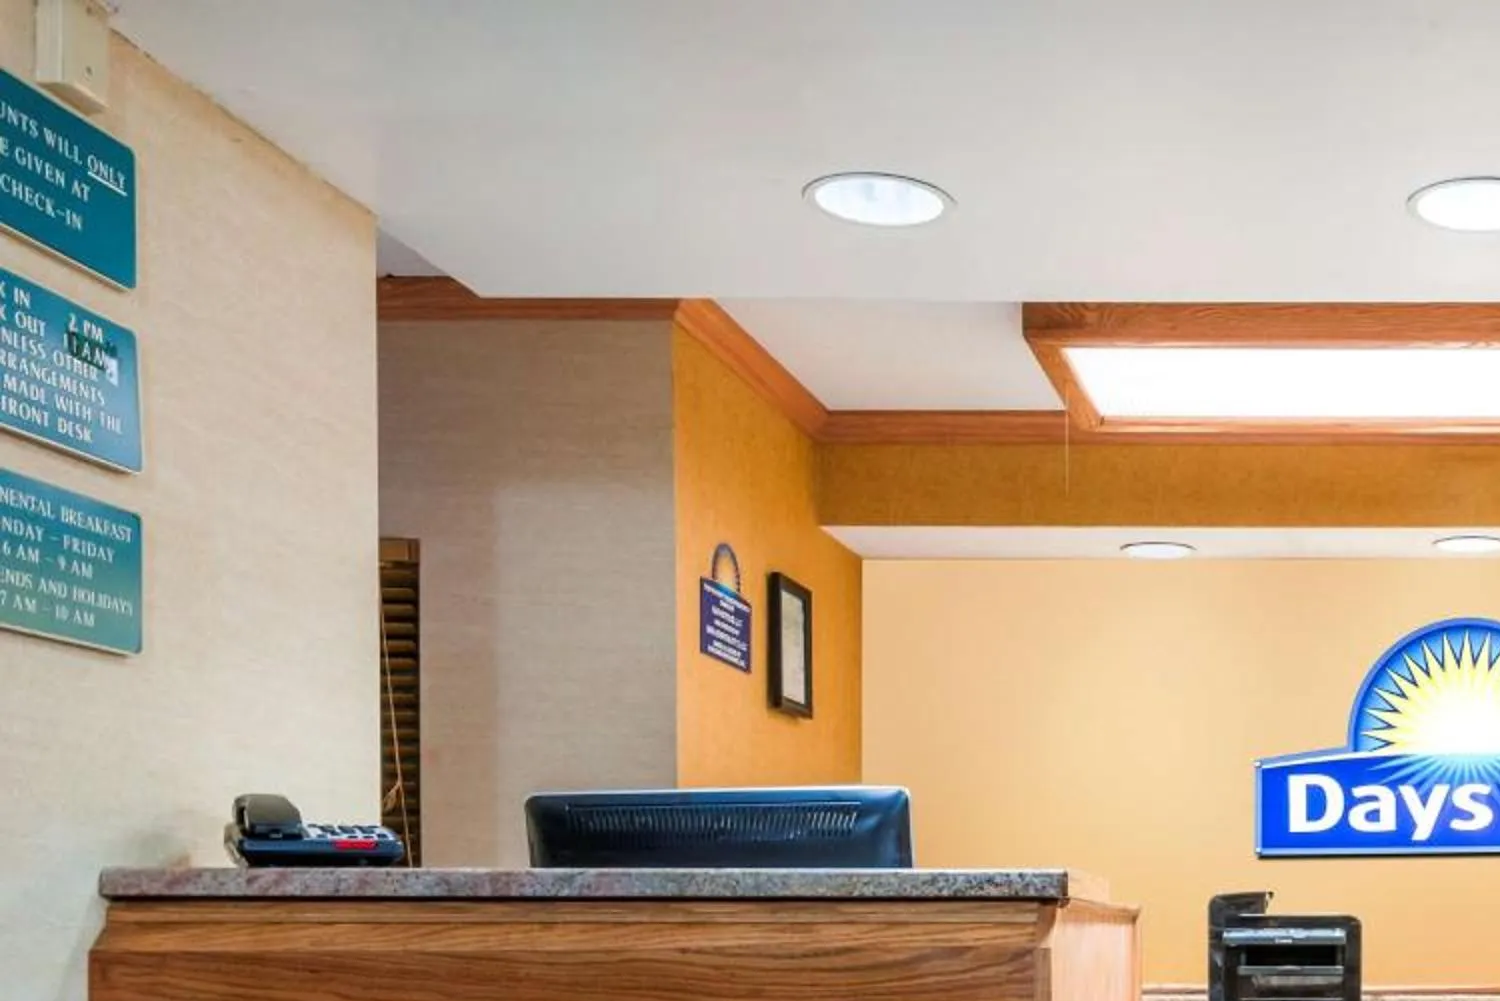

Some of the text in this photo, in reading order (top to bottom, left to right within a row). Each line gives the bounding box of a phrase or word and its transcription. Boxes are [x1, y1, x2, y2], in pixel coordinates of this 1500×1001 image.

[15, 146, 65, 188] GIVEN
[71, 179, 90, 202] AT
[43, 127, 83, 165] WILL
[87, 154, 127, 191] ONLY
[0, 173, 83, 231] CHECK-IN
[13, 286, 31, 310] IN
[83, 319, 104, 344] PM
[15, 310, 46, 338] OUT
[53, 350, 98, 382] OTHER
[1, 395, 92, 442] FRONT DESK
[3, 373, 123, 435] MADE WITH THE
[1, 516, 45, 543] NDAY
[63, 534, 115, 564] FRIDAY
[61, 507, 133, 543] BREAKFAST
[3, 541, 11, 556] 6
[16, 543, 39, 565] AM
[71, 559, 93, 580] AM
[13, 593, 37, 614] AM
[73, 609, 95, 628] AM
[38, 578, 67, 599] AND
[73, 585, 133, 617] HOLIDAYS
[1287, 772, 1492, 841] Days
